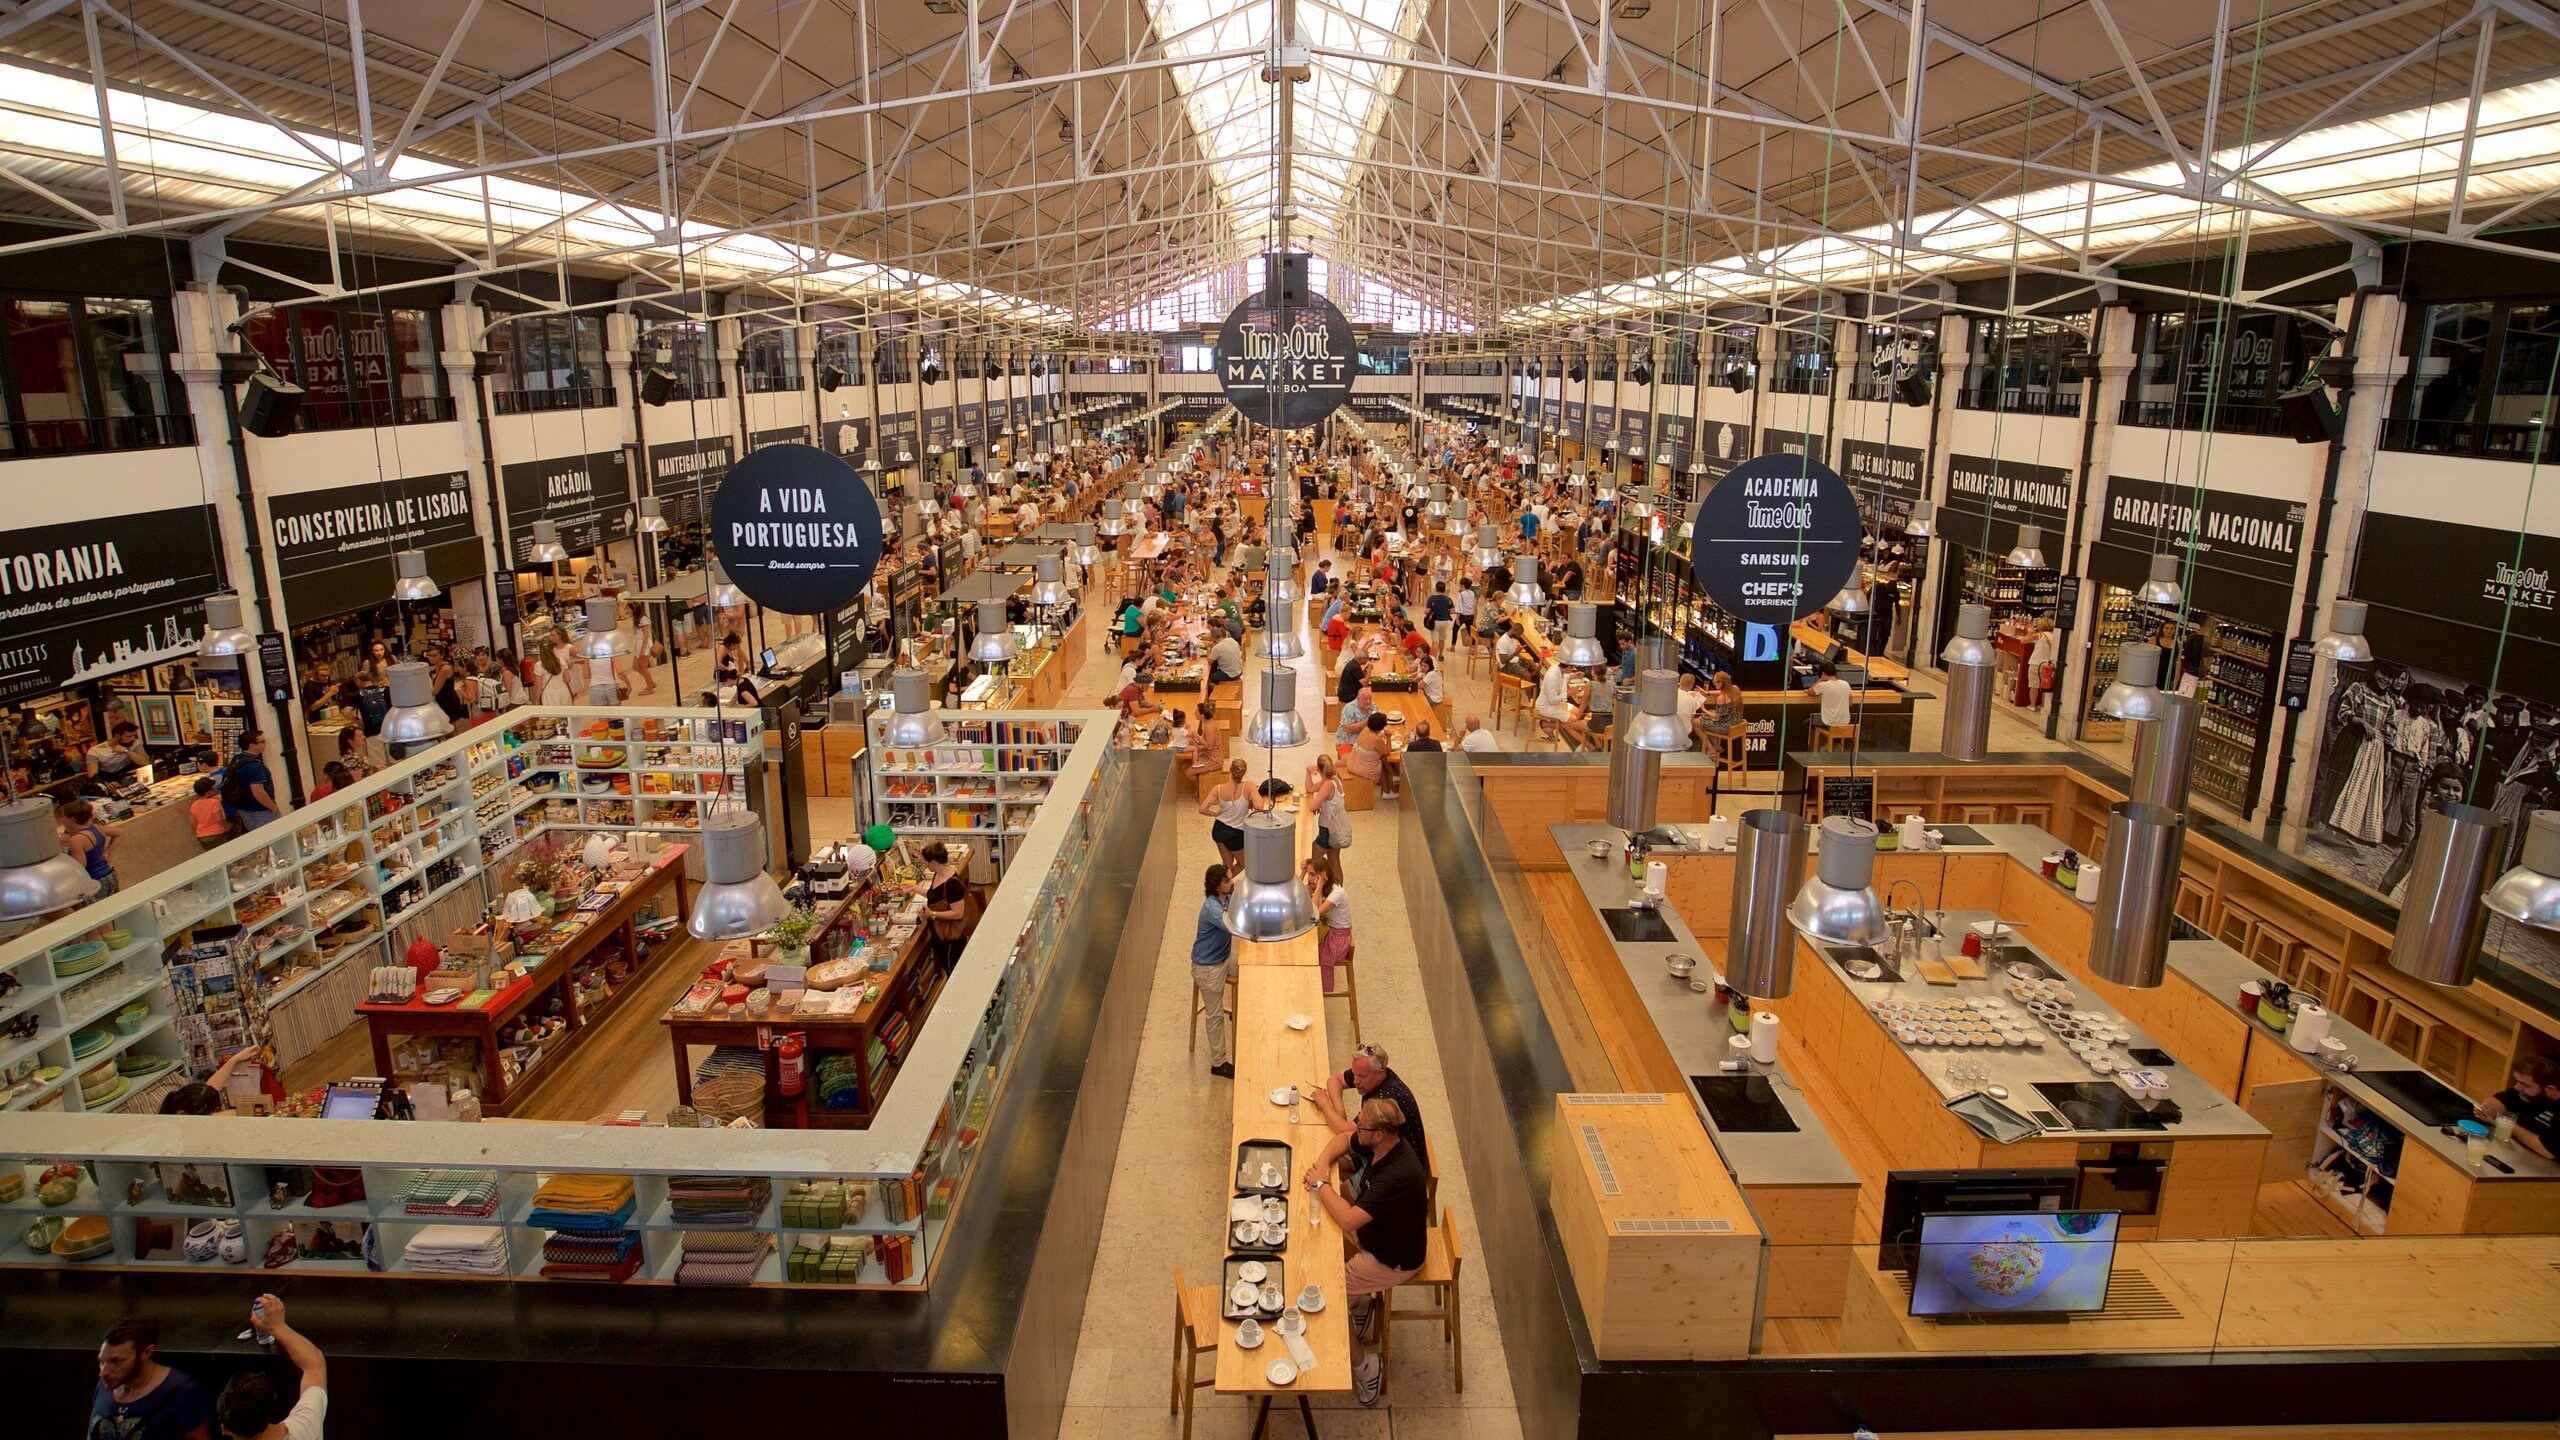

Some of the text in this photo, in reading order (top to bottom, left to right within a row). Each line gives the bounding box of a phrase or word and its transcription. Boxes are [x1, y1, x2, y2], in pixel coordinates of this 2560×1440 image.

[1240, 323, 1329, 360] Time Out
[1873, 338, 1905, 367] Estúdi
[1228, 364, 1345, 380] MARKET
[707, 449, 727, 468] SILVA
[1851, 450, 1865, 472] NÓS
[1866, 452, 1872, 472] É
[1872, 455, 1889, 476] MAS
[1891, 460, 1916, 481] BOLOS
[548, 469, 592, 498] ARCÁDIA
[1744, 478, 1818, 497] ACADEMIA
[1952, 469, 2068, 510] GARRAFEIRA NACIONAL
[760, 488, 826, 513] A VIDA
[275, 490, 469, 547] CONSERVEIRA DE LISBOA
[1747, 501, 1812, 529] Time Out
[2113, 495, 2294, 554] GARRAFEIRA NACIONAL
[732, 522, 858, 548] PORTUGUESA
[0, 541, 124, 595] TORANJA
[768, 560, 826, 571] Desde sempre
[1740, 553, 1810, 566] SAMSUNG
[2496, 561, 2548, 591] Time Out
[0, 577, 177, 621] produtos de autores portugueses
[1741, 582, 1804, 597] CHEF'S
[1744, 598, 1798, 606] EXPERIENCE
[2484, 583, 2555, 605] MARKET
[2504, 599, 2529, 608] LSBOA
[0, 643, 48, 670] RTISTS
[20, 675, 52, 690] PORTUGAL
[1745, 738, 1767, 751] BAR
